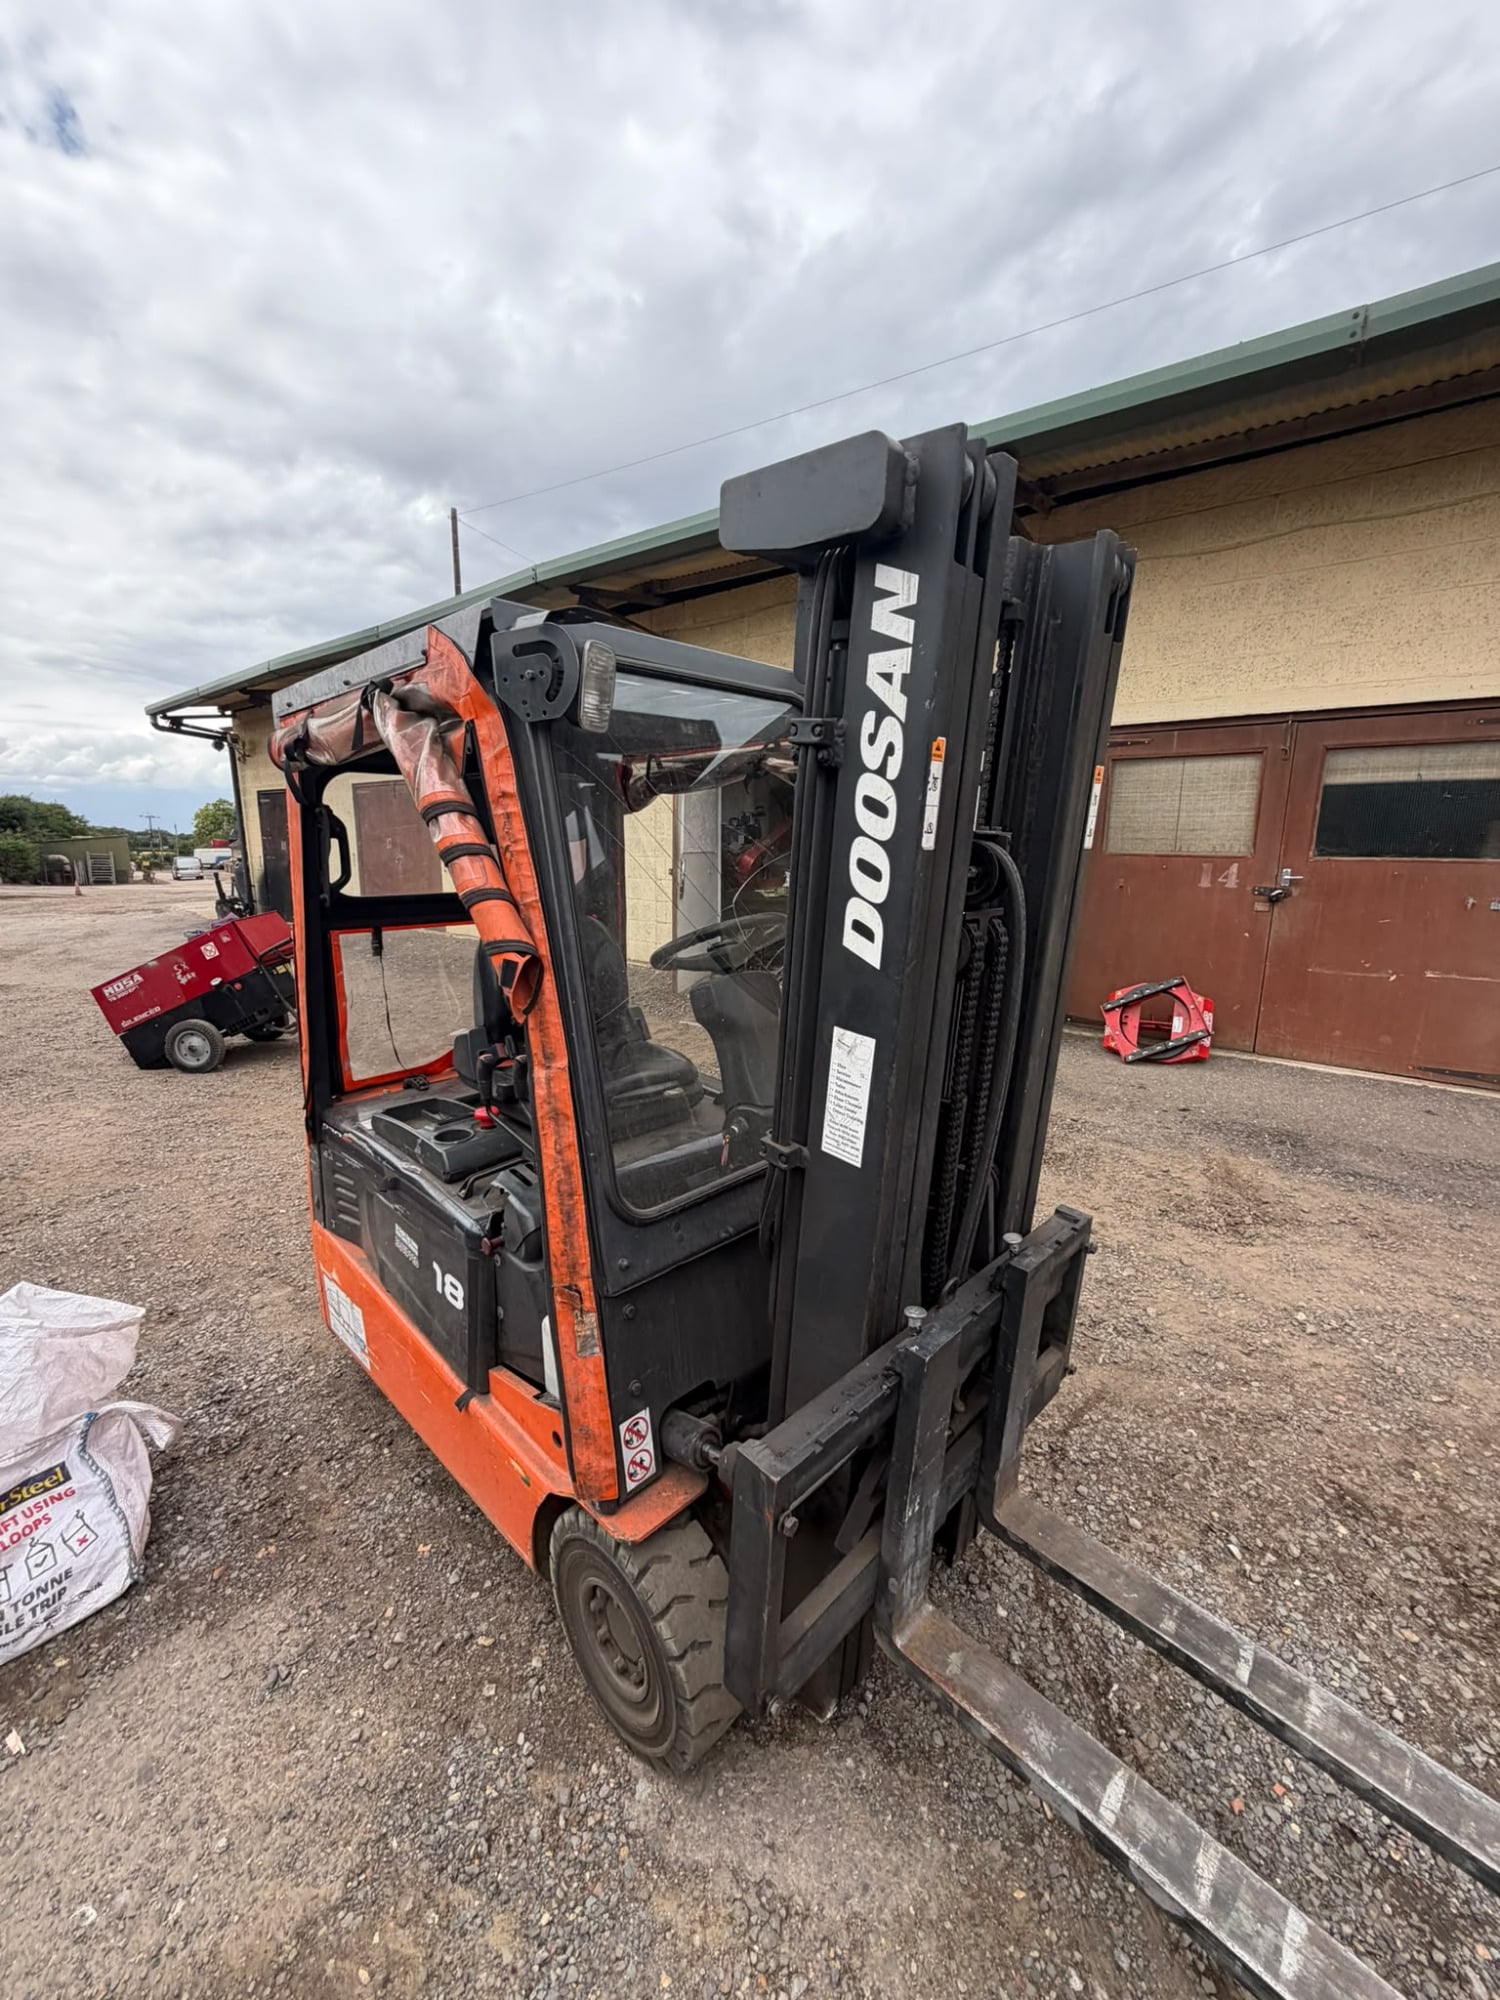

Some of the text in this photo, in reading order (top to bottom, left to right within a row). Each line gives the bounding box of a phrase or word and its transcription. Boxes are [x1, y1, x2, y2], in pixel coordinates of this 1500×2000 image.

[843, 563, 919, 970] DOOSAN
[1198, 862, 1239, 888] 14
[102, 973, 144, 998] MOSA
[432, 1260, 465, 1310] 18
[21, 1487, 76, 1519] USING
[0, 1513, 52, 1551] LOOPS
[10, 1567, 73, 1613] TONNE
[29, 1586, 67, 1618] TRIP
